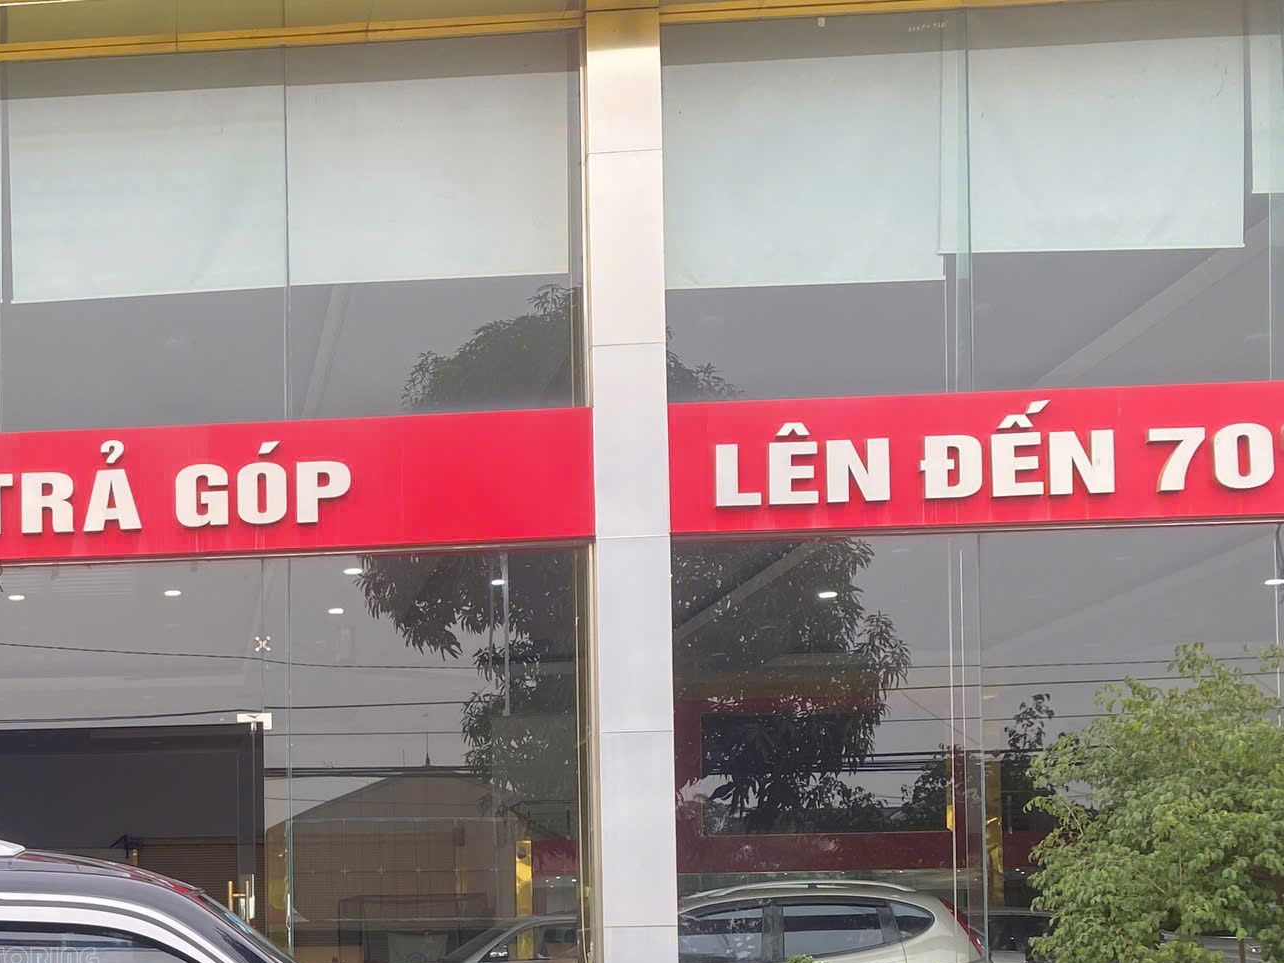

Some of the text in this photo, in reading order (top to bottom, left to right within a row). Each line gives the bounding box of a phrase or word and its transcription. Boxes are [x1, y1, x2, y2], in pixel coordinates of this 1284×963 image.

[175, 440, 352, 528] GÓP
[715, 399, 1284, 507] LÊN ĐẾN 70
